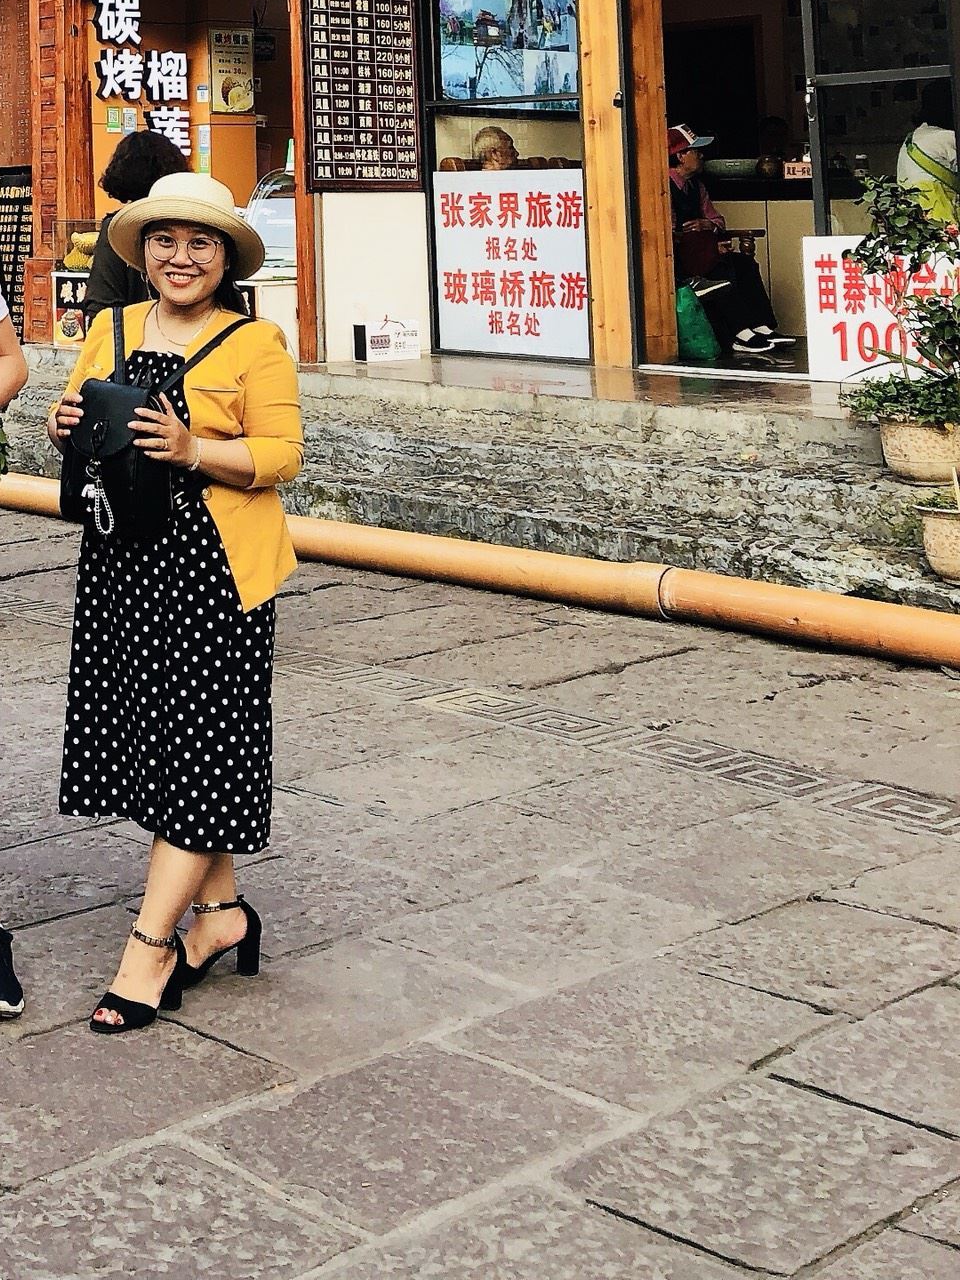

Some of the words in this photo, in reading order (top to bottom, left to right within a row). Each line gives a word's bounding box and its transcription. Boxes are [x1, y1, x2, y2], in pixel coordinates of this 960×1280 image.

[375, 3, 390, 13] 100
[393, 4, 408, 15] 3小时
[376, 19, 390, 29] 160
[393, 20, 411, 31] 5小时
[376, 35, 392, 45] 120
[376, 51, 392, 62] 220
[377, 68, 393, 78] 160
[378, 84, 393, 94] 160
[395, 86, 413, 97] 6小时
[378, 100, 394, 111] 165
[379, 117, 395, 128] 110
[381, 134, 393, 144] 40
[382, 150, 394, 161] 60
[381, 167, 397, 178] 280
[440, 191, 584, 229] 张家界旅游
[485, 236, 538, 261] 报名处
[443, 268, 589, 310] 玻璃桥旅游
[488, 310, 541, 337] 报名处
